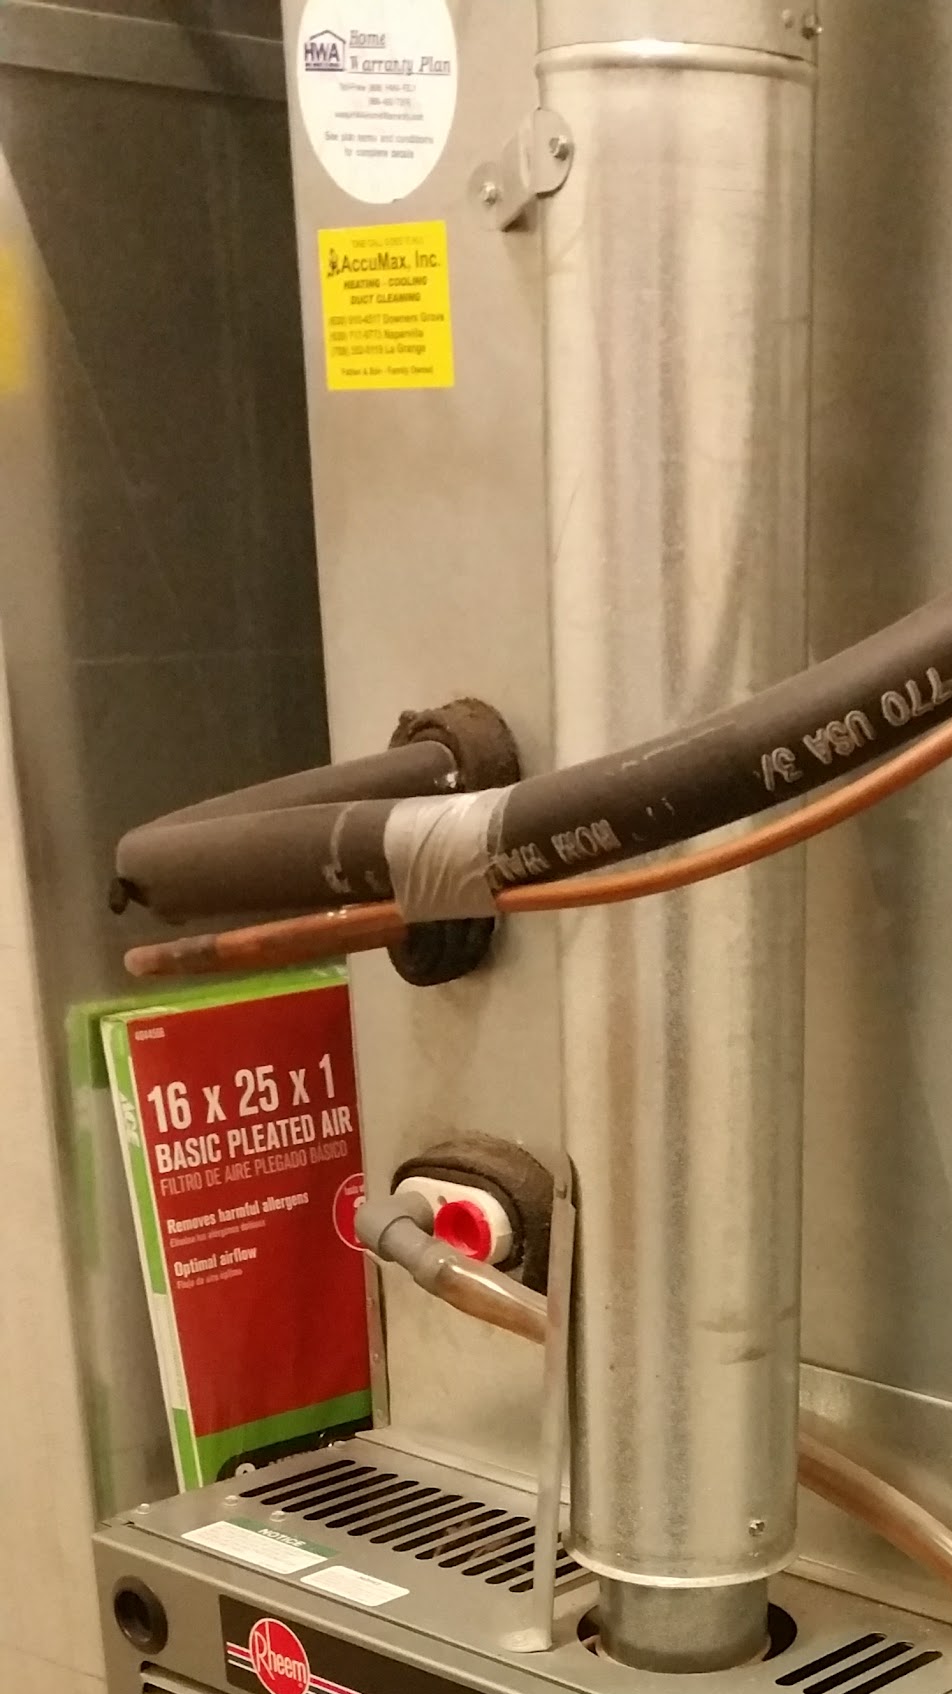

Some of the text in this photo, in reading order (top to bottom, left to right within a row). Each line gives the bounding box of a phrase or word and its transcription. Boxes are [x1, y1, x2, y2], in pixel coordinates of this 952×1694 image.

[304, 29, 386, 62] HWA Home
[350, 55, 452, 76] Warranty Plan
[414, 249, 441, 269] Inc.
[343, 276, 428, 290] HEATING COOLING
[350, 292, 421, 305] DUCT CLEANING
[802, 709, 876, 765] USA
[147, 1053, 335, 1134] 16 x 25 x 1
[155, 1105, 354, 1174] BASIC PLEATED AIR
[160, 1138, 349, 1197] FILTRO DE AIRE PLEGADO BÁSICO
[167, 1212, 217, 1235] Removes
[218, 1198, 260, 1224] harmful
[261, 1191, 309, 1212] allergens
[174, 1246, 258, 1279] Optimal airflow
[258, 1527, 307, 1548] NOTICE
[253, 1620, 308, 1685] Rheem
